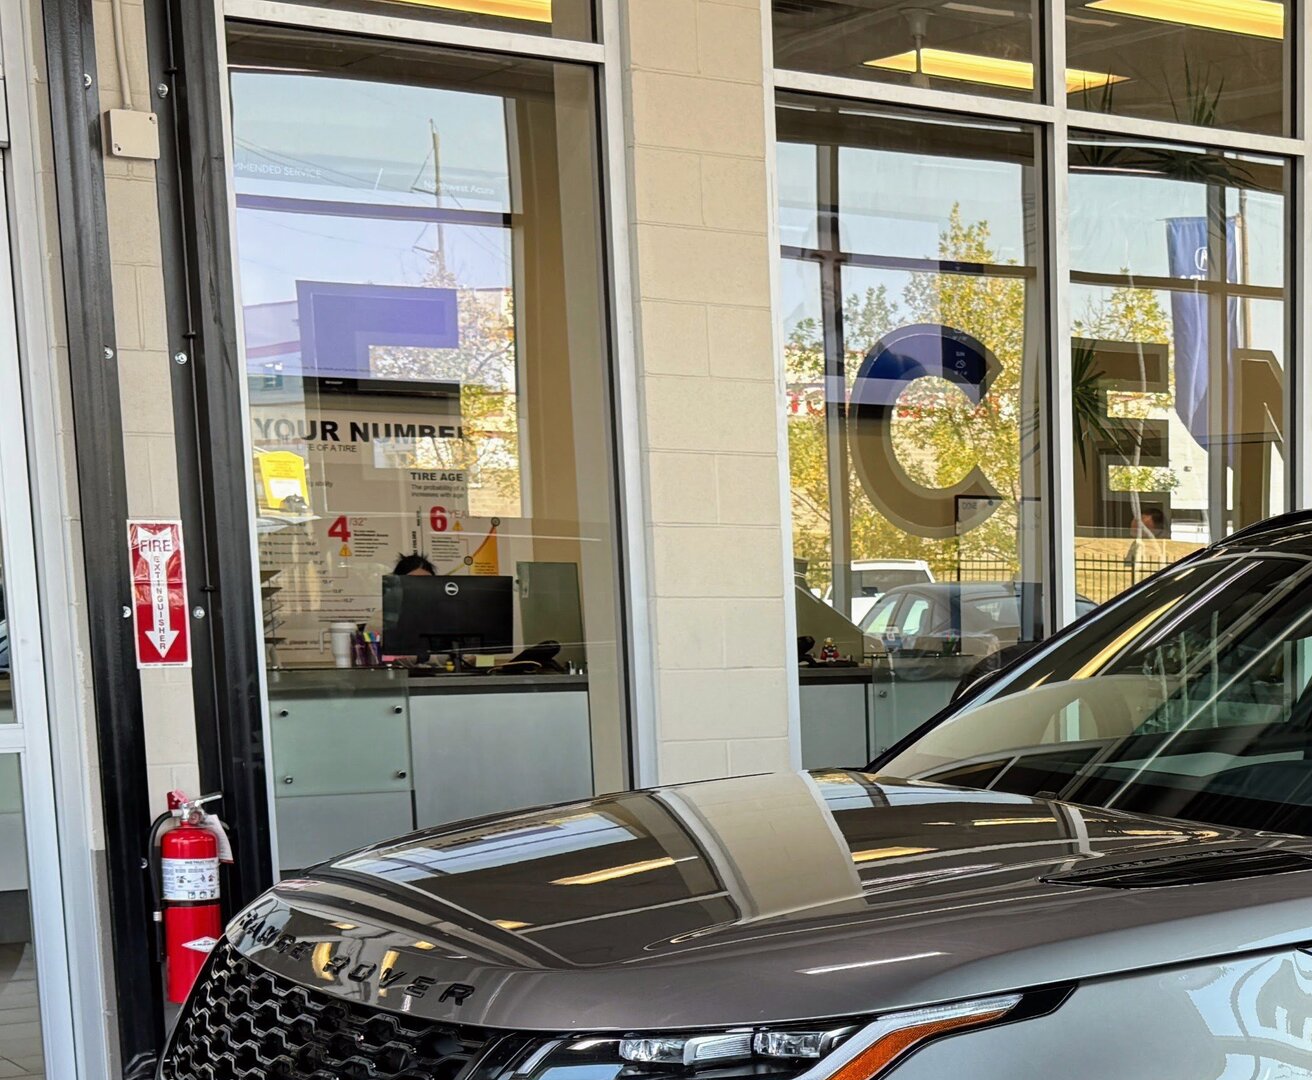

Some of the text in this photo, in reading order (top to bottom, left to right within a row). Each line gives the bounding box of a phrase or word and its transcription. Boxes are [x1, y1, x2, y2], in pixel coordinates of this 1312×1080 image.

[253, 418, 340, 441] YOUR
[410, 472, 464, 481] TIRE AGE
[327, 514, 352, 542] 4
[430, 506, 448, 532] 6
[140, 539, 172, 553] FIRE
[153, 555, 166, 650] EXTINGUISHER
[322, 955, 475, 1007] ROVER
